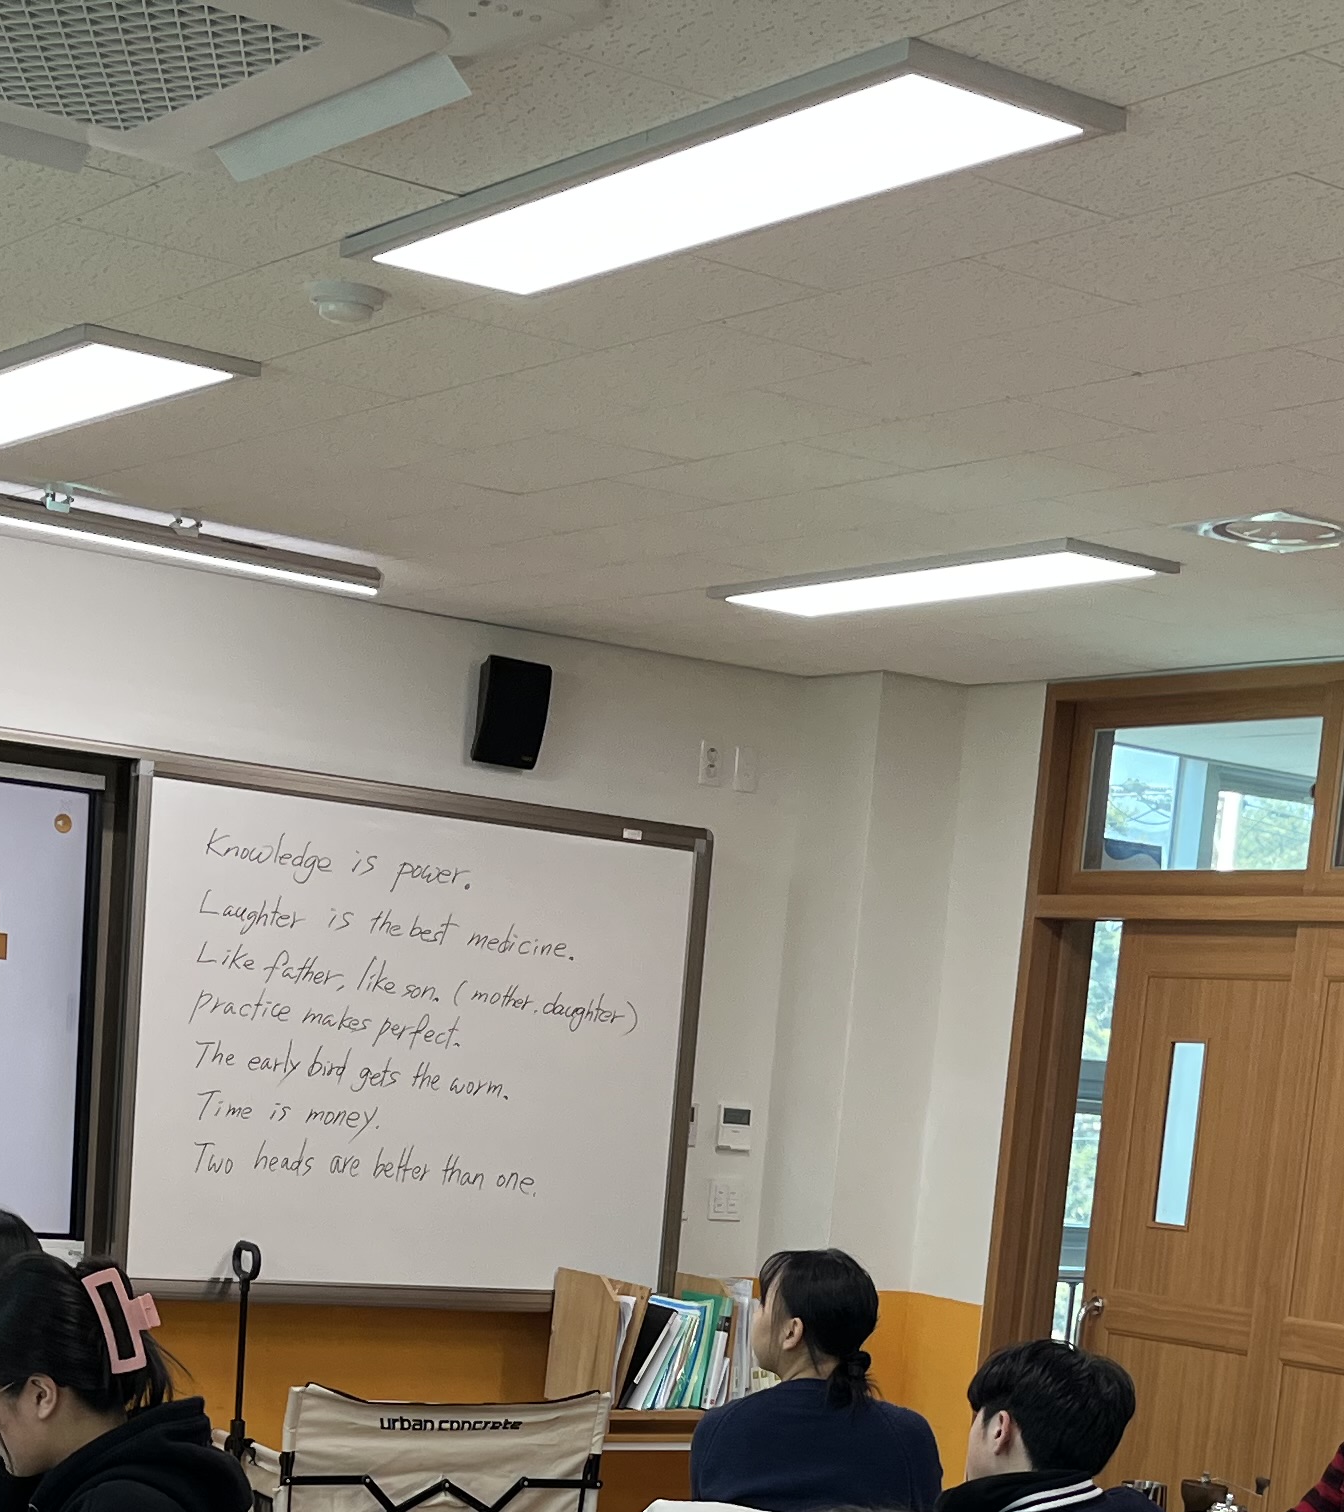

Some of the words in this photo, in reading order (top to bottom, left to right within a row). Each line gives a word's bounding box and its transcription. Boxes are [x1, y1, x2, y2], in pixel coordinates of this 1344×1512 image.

[205, 828, 333, 884] Knowledge
[352, 850, 378, 876] is
[390, 861, 471, 892] power.
[199, 889, 306, 935] Laughter
[328, 907, 355, 931] is
[467, 924, 574, 961] medicine.
[197, 941, 255, 970] Like
[263, 950, 346, 992] father,
[356, 956, 396, 994] like
[400, 983, 440, 1003] son.
[301, 1005, 373, 1033] makes
[371, 1013, 461, 1050] perfect.
[194, 1039, 236, 1069] The
[247, 1038, 302, 1088] early
[307, 1044, 353, 1085] bird
[350, 1056, 402, 1093] gets
[411, 1061, 441, 1092] the
[449, 1076, 509, 1101] worm.
[197, 1089, 253, 1121] Time
[269, 1102, 292, 1122] is
[304, 1105, 381, 1145] money.
[193, 1140, 234, 1174] Two
[253, 1136, 315, 1177] heads
[329, 1154, 361, 1178] are
[372, 1146, 431, 1183] better
[441, 1153, 485, 1191] than
[379, 1416, 435, 1431] urban
[437, 1418, 523, 1431] concrete
